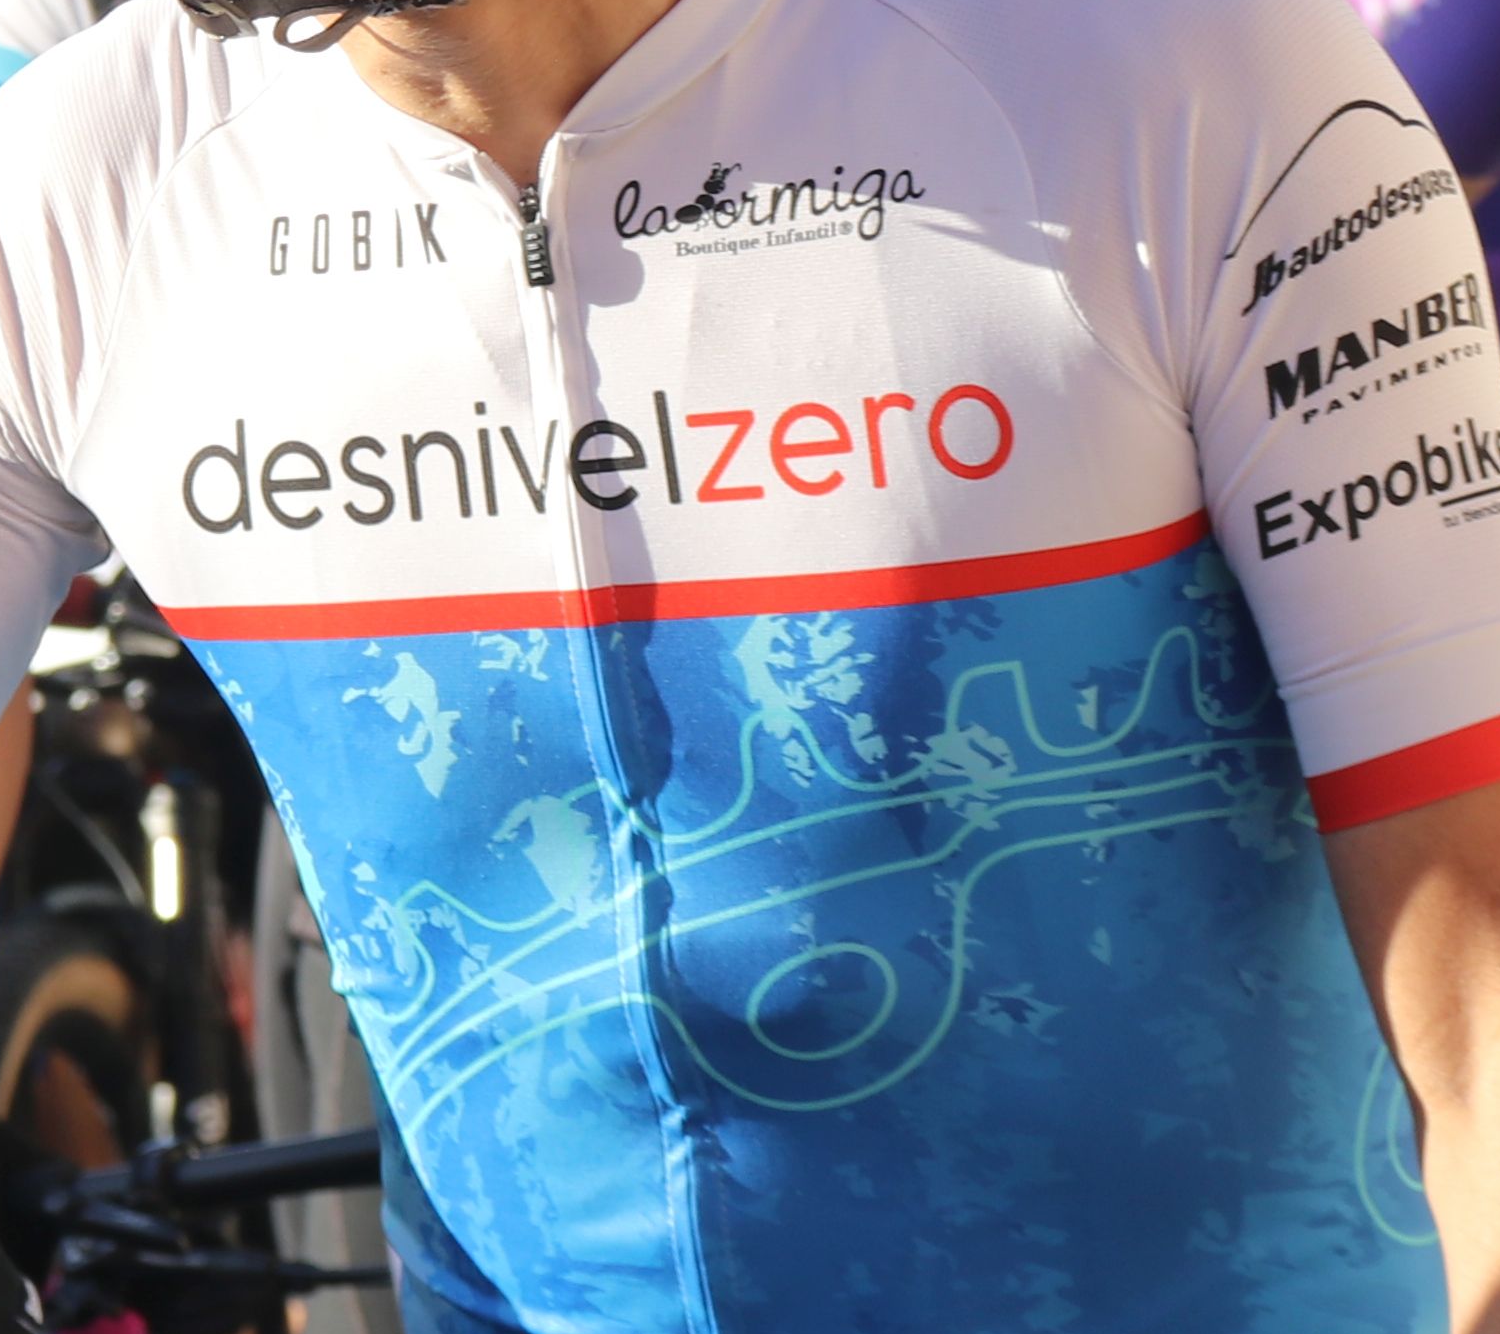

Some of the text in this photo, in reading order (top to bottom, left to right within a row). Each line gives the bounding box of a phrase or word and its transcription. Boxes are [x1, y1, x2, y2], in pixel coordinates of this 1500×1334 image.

[268, 201, 448, 277] GOBIK
[675, 232, 761, 258] Boutique
[1264, 271, 1488, 420] MANBER
[1302, 341, 1483, 425] PAVIMENTOS
[182, 383, 1015, 535] desnivelzero
